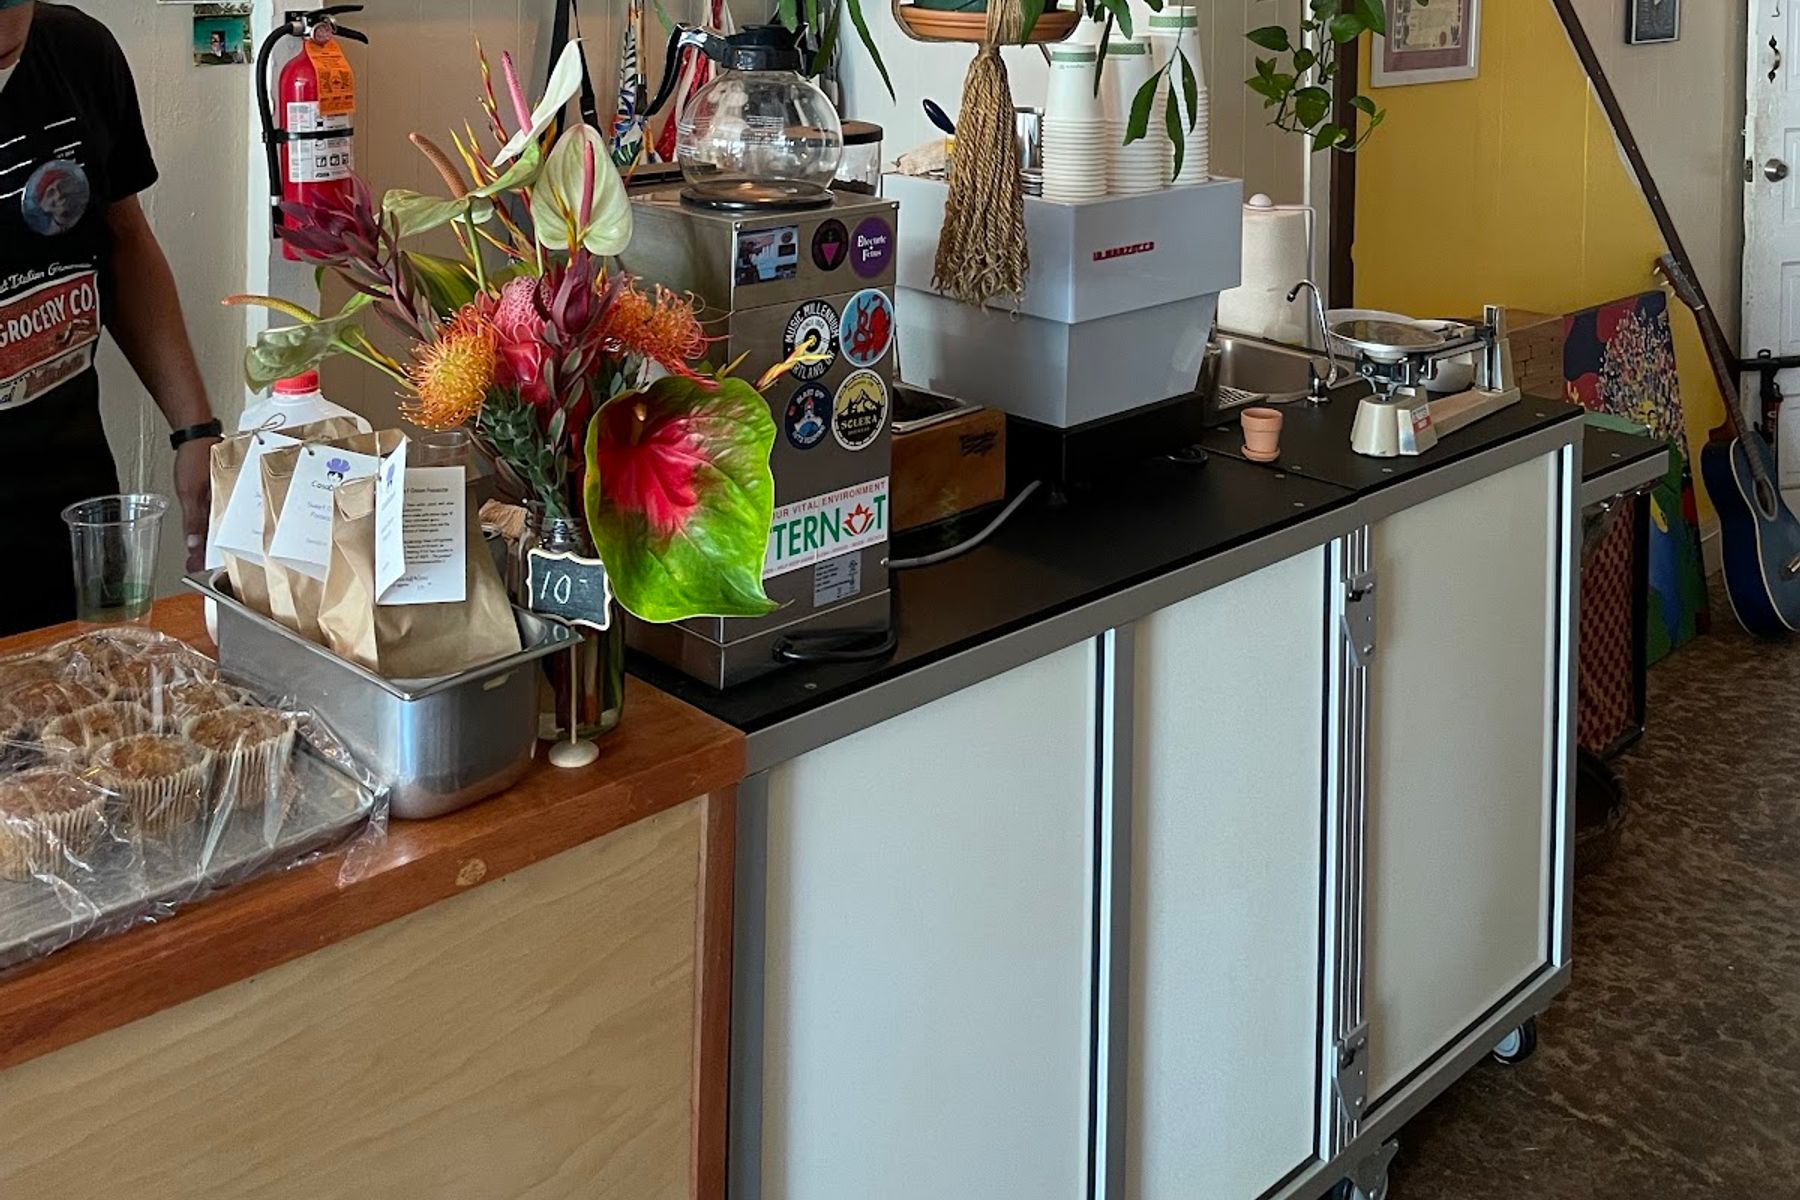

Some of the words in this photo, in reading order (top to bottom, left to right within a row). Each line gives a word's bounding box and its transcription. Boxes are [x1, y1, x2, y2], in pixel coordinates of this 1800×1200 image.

[0, 294, 67, 348] GROCERY
[69, 282, 96, 316] CO.
[785, 311, 804, 343] MUSIC
[772, 507, 788, 521] UR
[793, 501, 819, 515] VITAL
[822, 481, 886, 506] ENVIRONMENT
